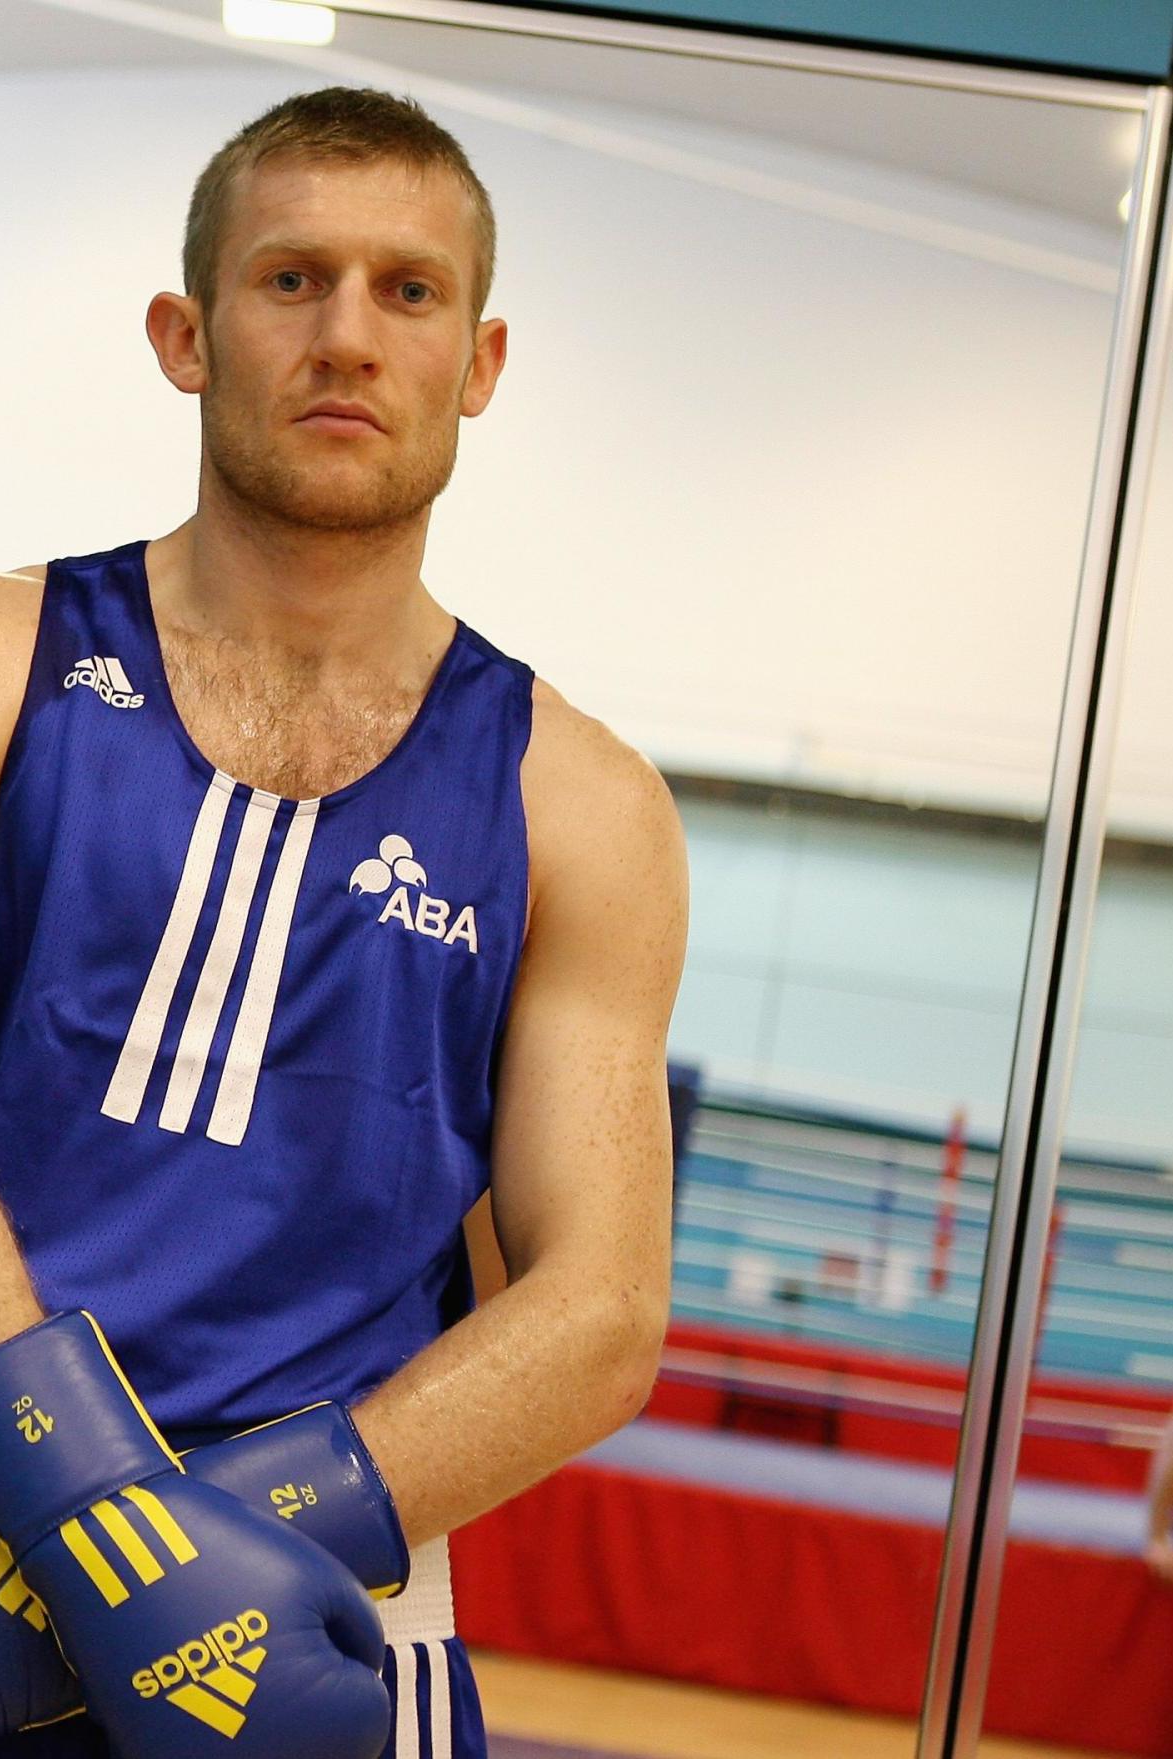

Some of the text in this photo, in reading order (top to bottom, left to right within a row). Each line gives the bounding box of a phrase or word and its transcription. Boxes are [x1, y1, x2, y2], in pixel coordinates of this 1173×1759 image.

[63, 665, 145, 709] adidas
[378, 886, 478, 954] ABA
[16, 1408, 54, 1444] 12
[269, 1483, 303, 1520] 12
[131, 1609, 269, 1699] adidas
